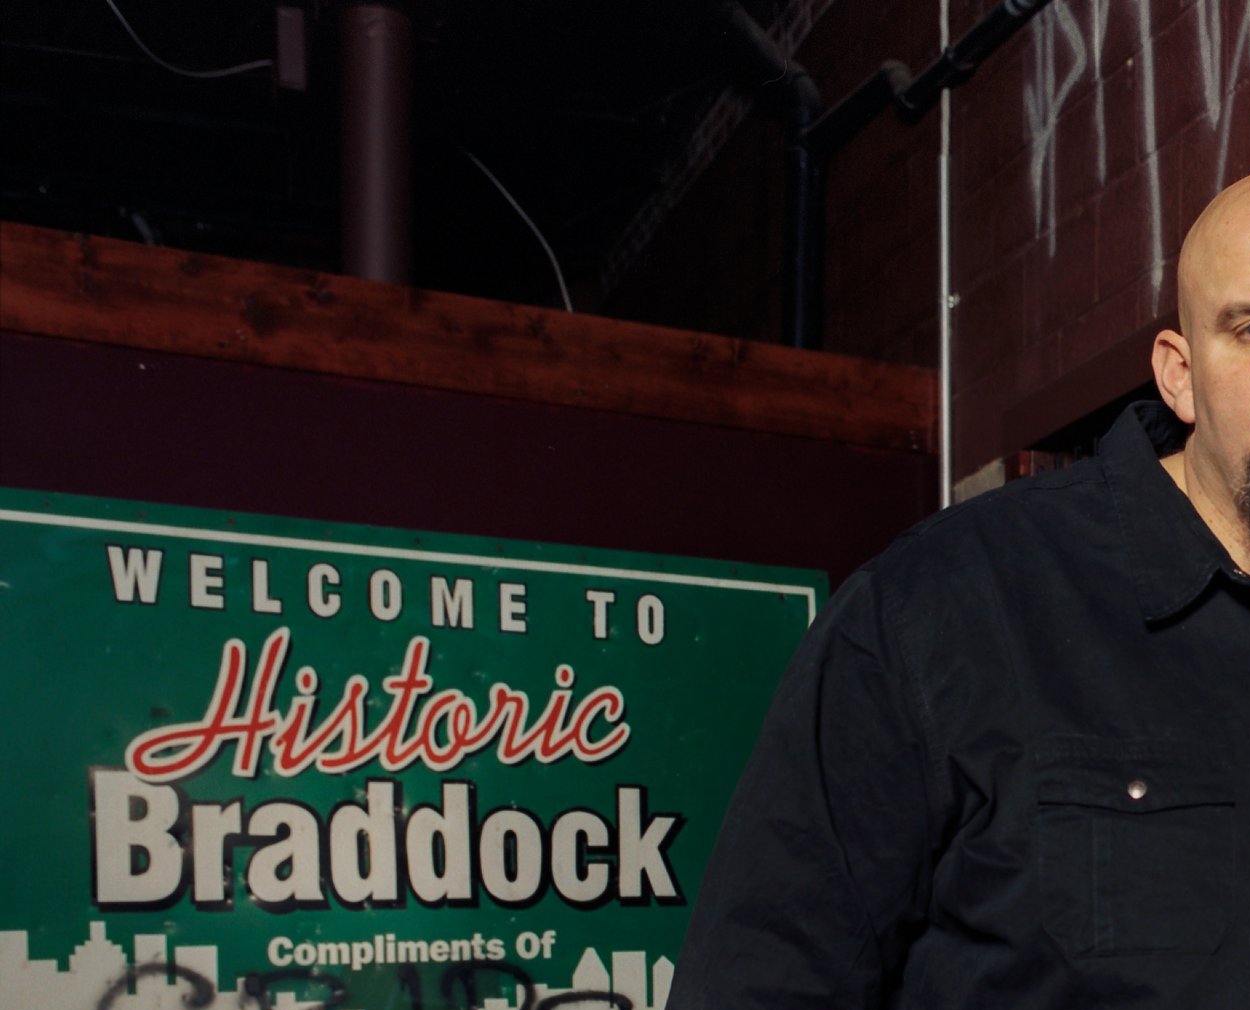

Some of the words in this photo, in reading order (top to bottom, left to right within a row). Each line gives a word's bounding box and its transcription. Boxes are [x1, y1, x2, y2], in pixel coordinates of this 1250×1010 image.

[107, 545, 529, 633] WELCOME
[586, 589, 665, 645] TO
[126, 627, 631, 783] Historic
[92, 768, 685, 909] Braddock
[267, 933, 506, 971] Compliments
[515, 930, 557, 960] Of
